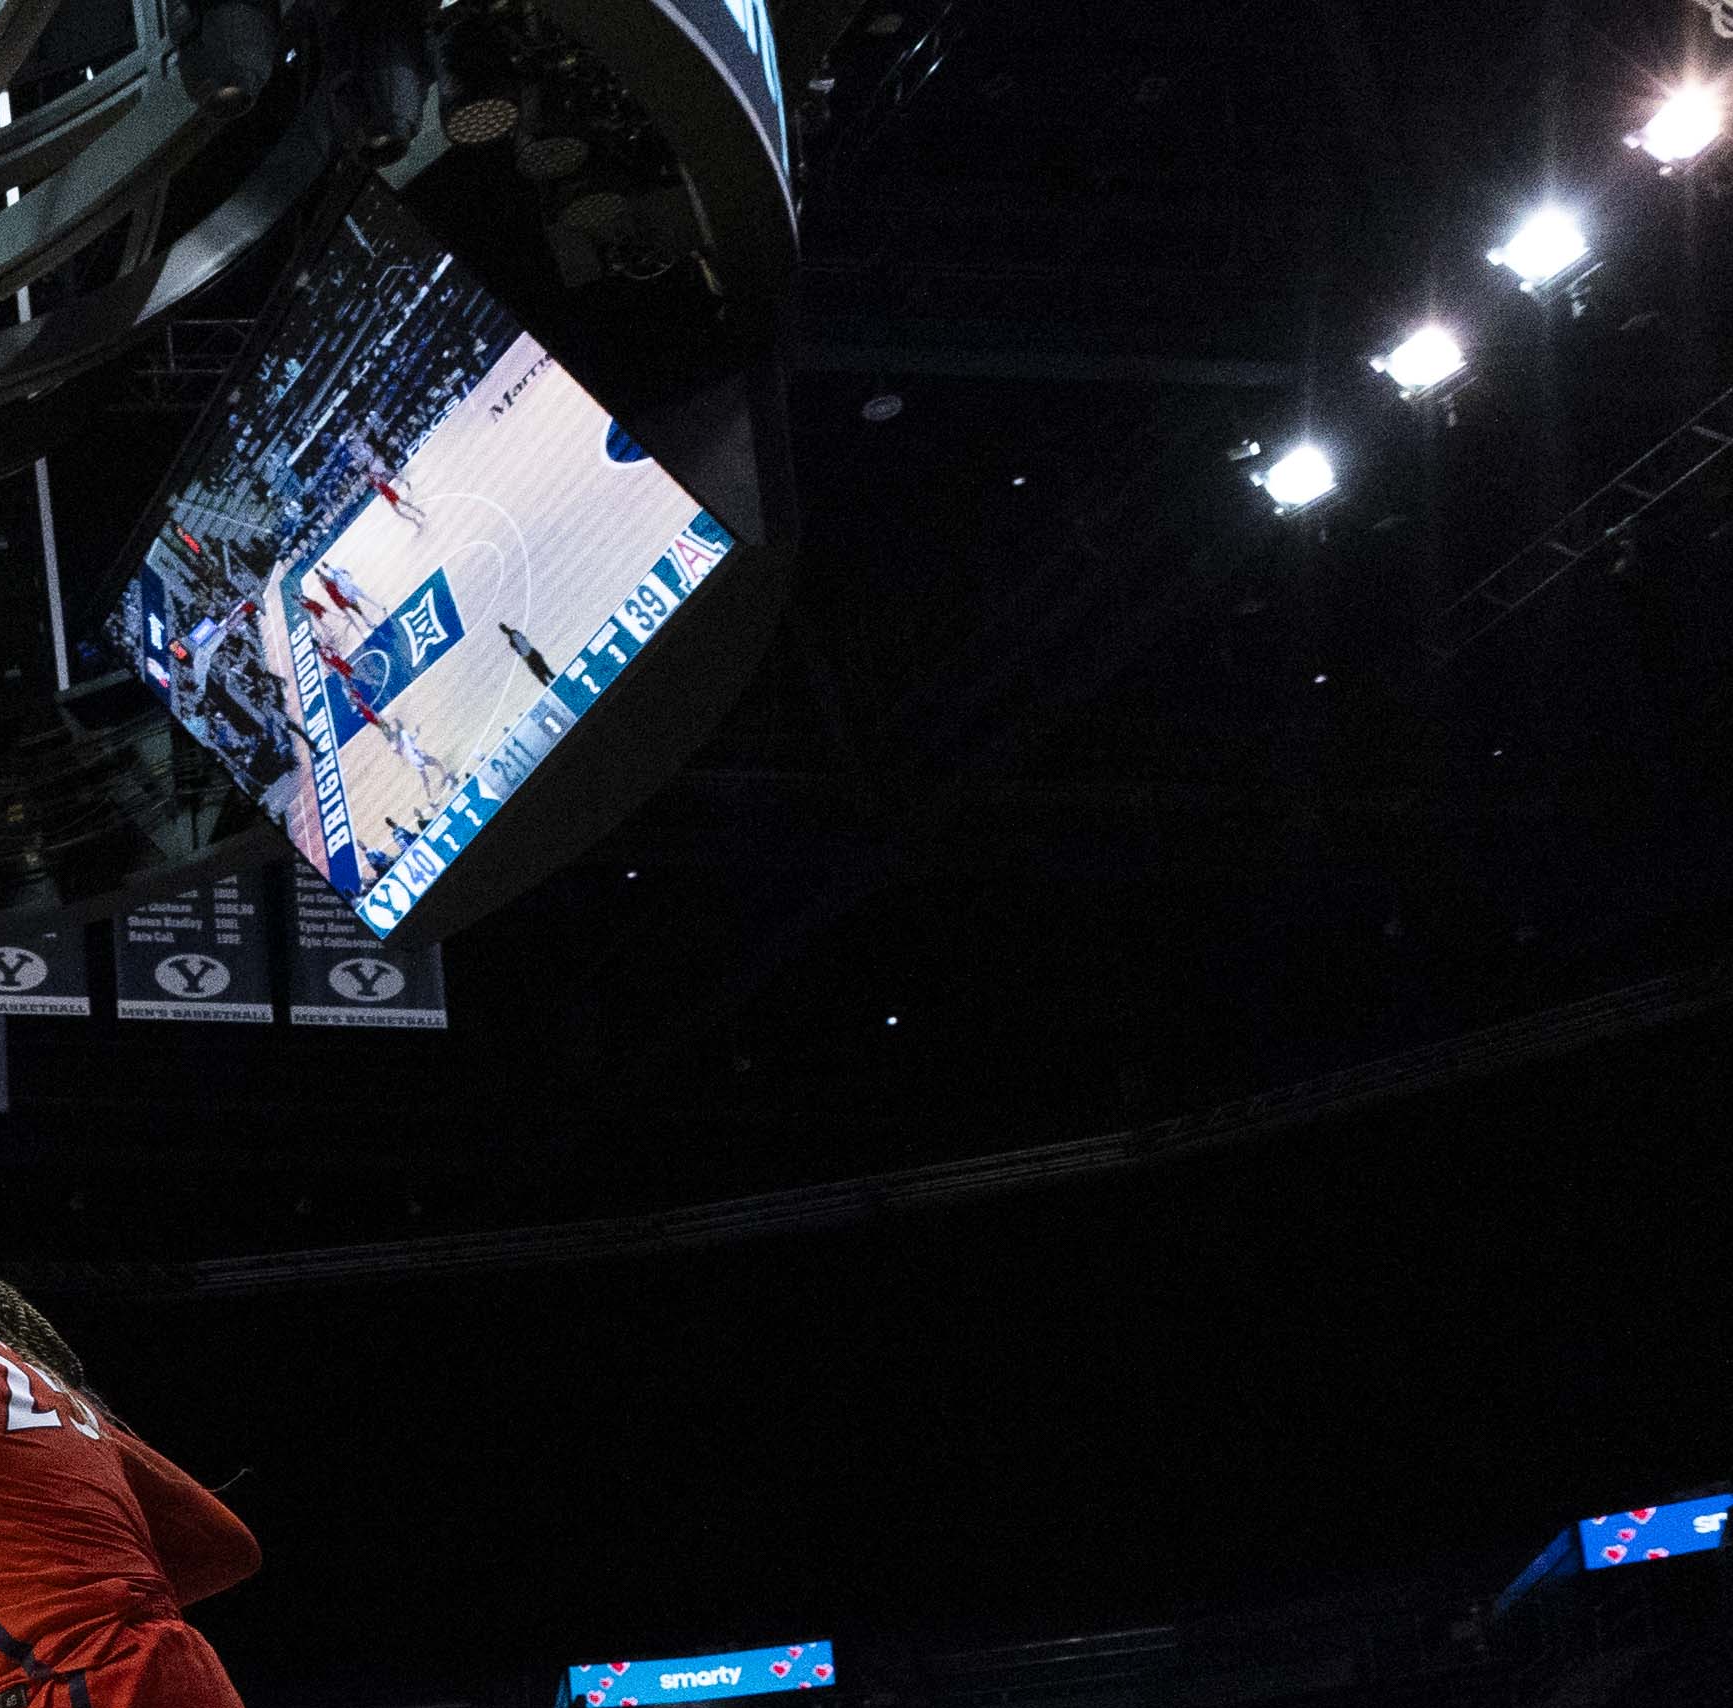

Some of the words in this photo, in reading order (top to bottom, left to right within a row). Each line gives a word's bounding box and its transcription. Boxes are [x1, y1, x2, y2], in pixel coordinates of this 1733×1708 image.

[624, 584, 669, 634] 39
[290, 620, 322, 712] YOUNG
[306, 706, 351, 859] BRIGHAM
[405, 847, 438, 885] 40
[659, 1665, 743, 1691] smarty
